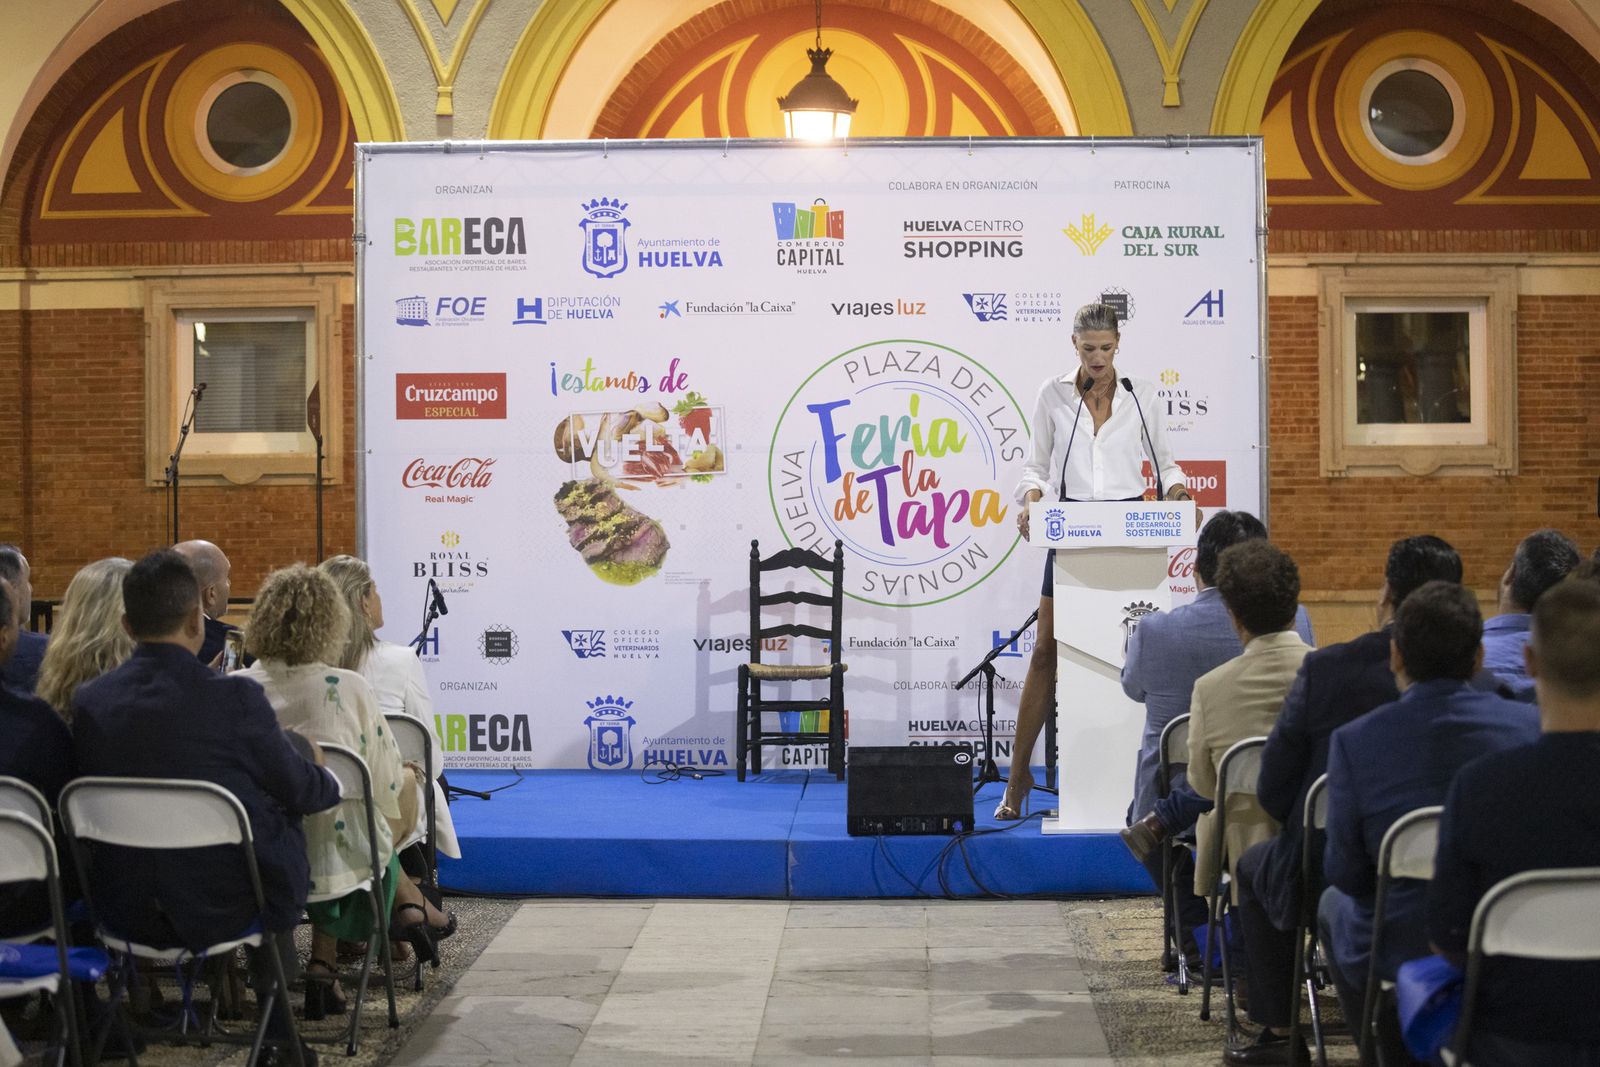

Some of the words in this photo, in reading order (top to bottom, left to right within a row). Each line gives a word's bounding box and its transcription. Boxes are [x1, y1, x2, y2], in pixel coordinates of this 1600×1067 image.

[435, 185, 493, 195] ORGANIZAN
[888, 181, 943, 191] COLABORA
[946, 181, 960, 190] EN
[962, 179, 1038, 190] ORGANIZACIÓN
[1113, 180, 1171, 190] PATROCINA
[394, 217, 527, 256] BARECA
[1122, 226, 1163, 240] CAJA
[1167, 225, 1224, 239] RURAL
[637, 238, 705, 249] Ayuntamiento
[708, 238, 720, 247] de
[903, 241, 1023, 258] SHOPPING
[1123, 244, 1158, 256] DEL
[1164, 243, 1199, 256] SUR
[638, 251, 723, 267] HUELVA
[777, 248, 844, 266] CAPITAL
[436, 297, 487, 316] FOE
[548, 295, 621, 307] DIPUTACIÓN
[686, 302, 744, 314] Fundación
[548, 309, 563, 319] DE
[566, 308, 614, 319] HUELVA
[659, 357, 689, 393] de
[843, 350, 942, 384] PLAZA
[405, 384, 498, 404] Cruzcampo
[950, 366, 994, 406] DE
[1157, 390, 1190, 398] OYAL
[424, 407, 479, 417] ESPECIAL
[1167, 400, 1208, 416] ISS
[806, 393, 968, 484] Feria
[986, 406, 1024, 462] LAS
[402, 457, 497, 488] Coca-Cola
[834, 471, 873, 521] de
[902, 449, 941, 498] la
[425, 495, 444, 503] Real
[446, 495, 474, 504] Magic
[781, 450, 832, 557] HUELVA
[855, 465, 1008, 549] Tapa
[1125, 512, 1181, 521] OBJETIVOS
[1125, 529, 1181, 537] SOSTENIBLE
[430, 552, 471, 560] ROYAL
[413, 561, 488, 578] BLISS
[862, 542, 989, 596] MONJAS
[1169, 585, 1196, 593] Magic
[849, 636, 907, 648] Fundación
[439, 681, 498, 691] ORGANIZAN
[893, 681, 948, 690] COLABORA
[434, 714, 532, 752] RECA
[642, 736, 711, 747] Ayuntamiento
[713, 736, 725, 745] de
[643, 749, 729, 766] HUELVA
[782, 748, 829, 765] CAPIT
